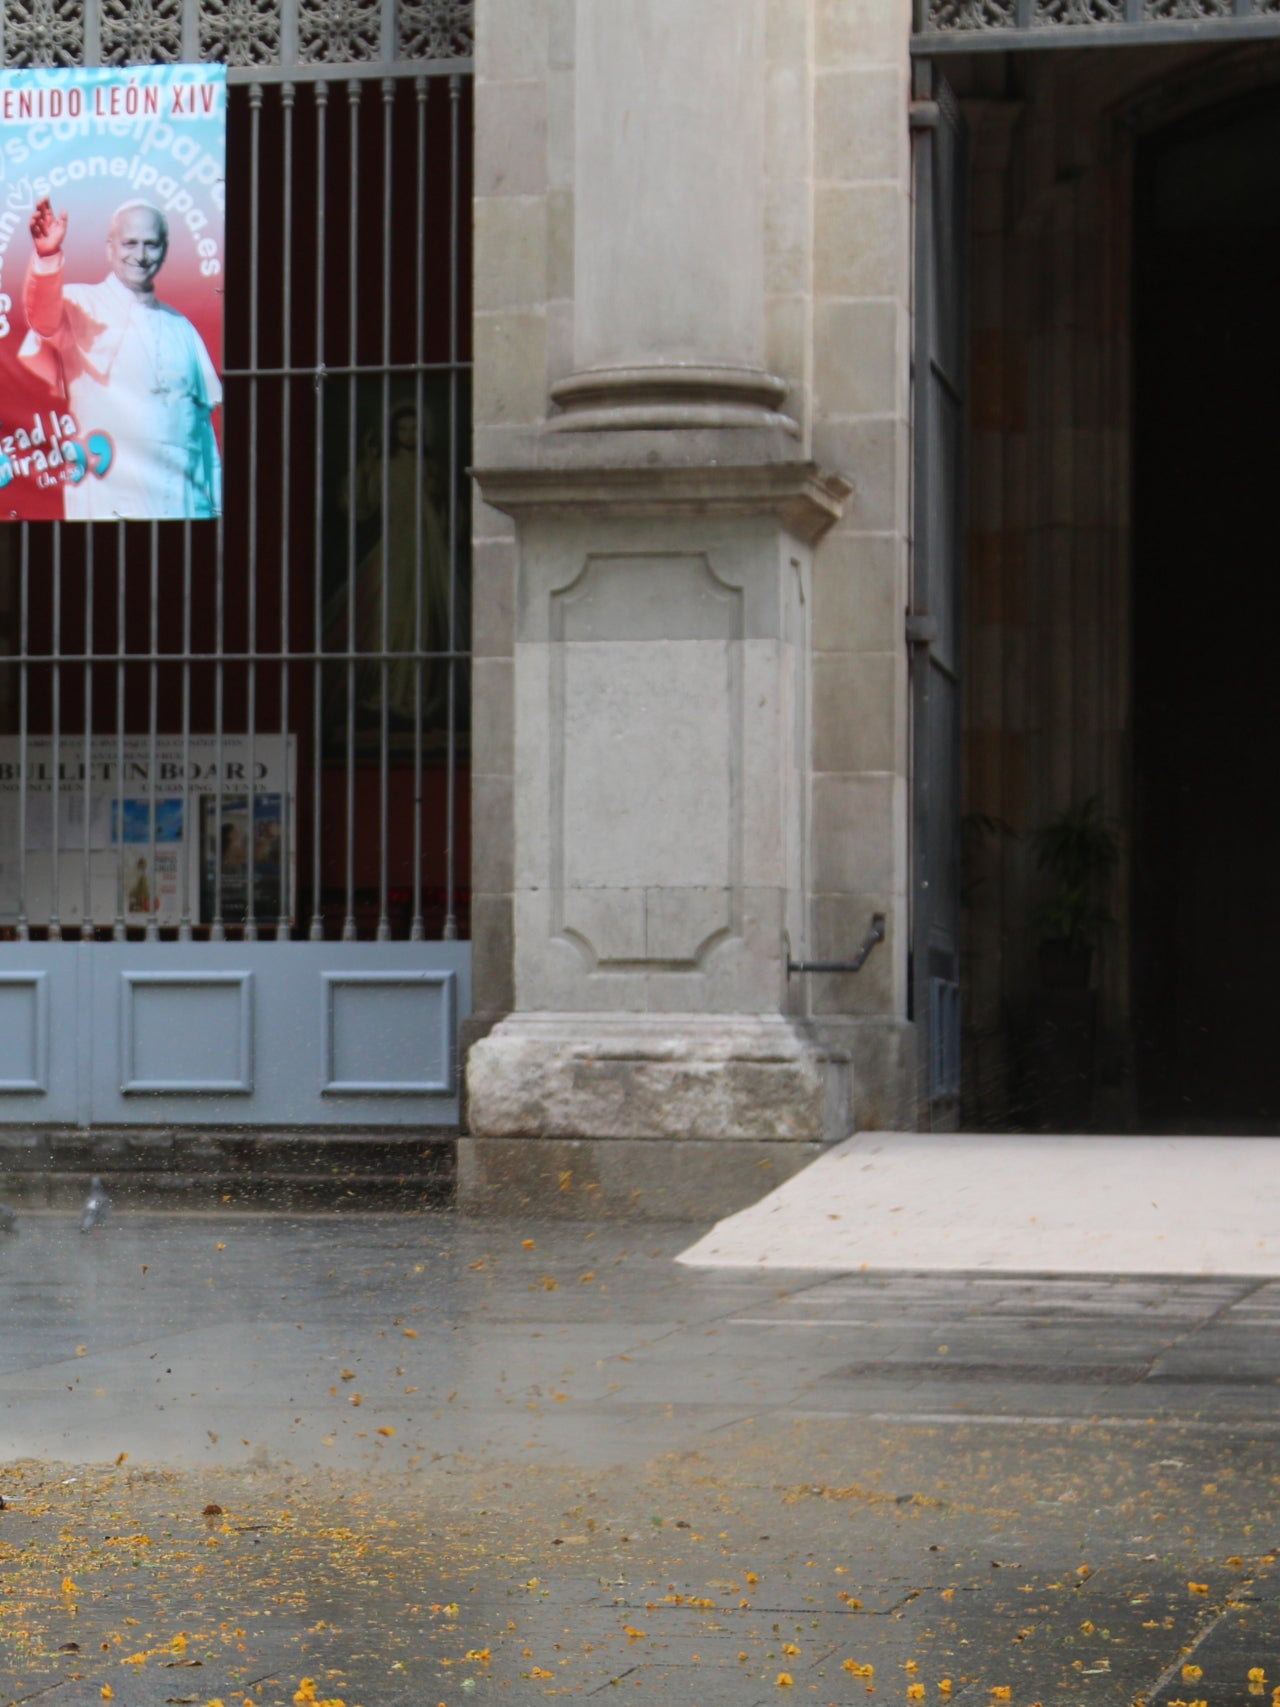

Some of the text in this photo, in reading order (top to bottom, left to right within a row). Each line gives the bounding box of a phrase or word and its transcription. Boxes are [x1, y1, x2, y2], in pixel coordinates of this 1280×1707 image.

[95, 78, 159, 116] LEÓN
[172, 84, 214, 114] XIV
[49, 410, 77, 439] la
[160, 762, 268, 780] BOARD
